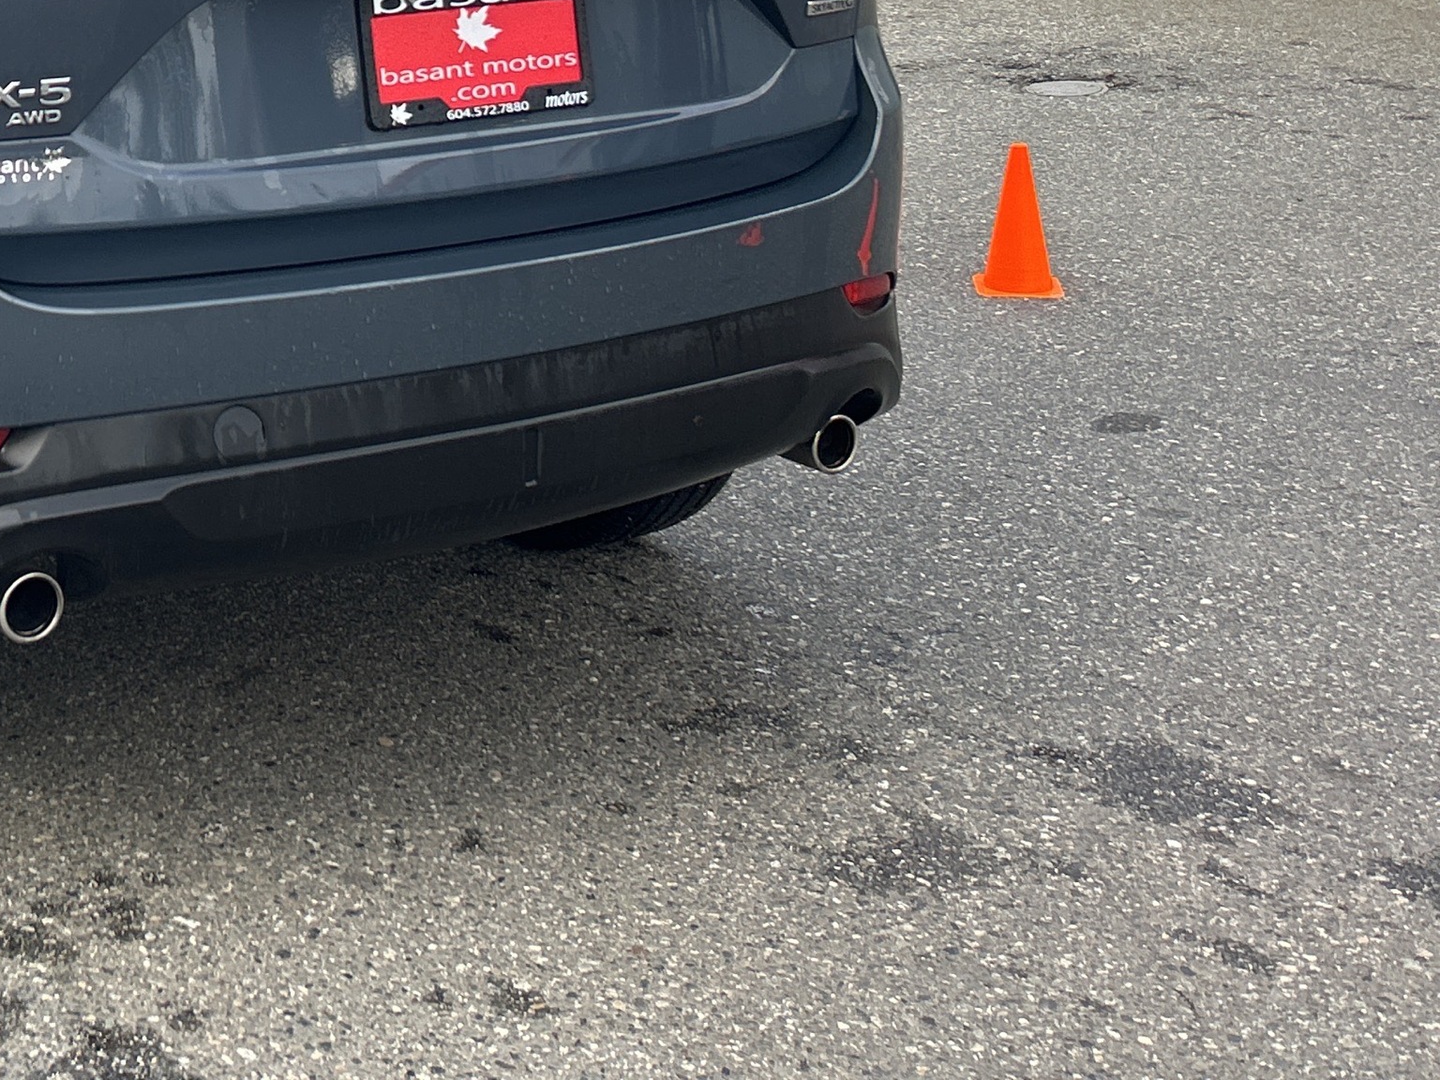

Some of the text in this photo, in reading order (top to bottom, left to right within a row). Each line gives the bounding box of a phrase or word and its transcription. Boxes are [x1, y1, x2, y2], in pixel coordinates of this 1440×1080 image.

[380, 51, 577, 86] basant motors
[451, 81, 516, 102] .com
[545, 90, 588, 108] motors
[5, 108, 62, 127] AWD
[446, 100, 530, 121] 604.572.7880
